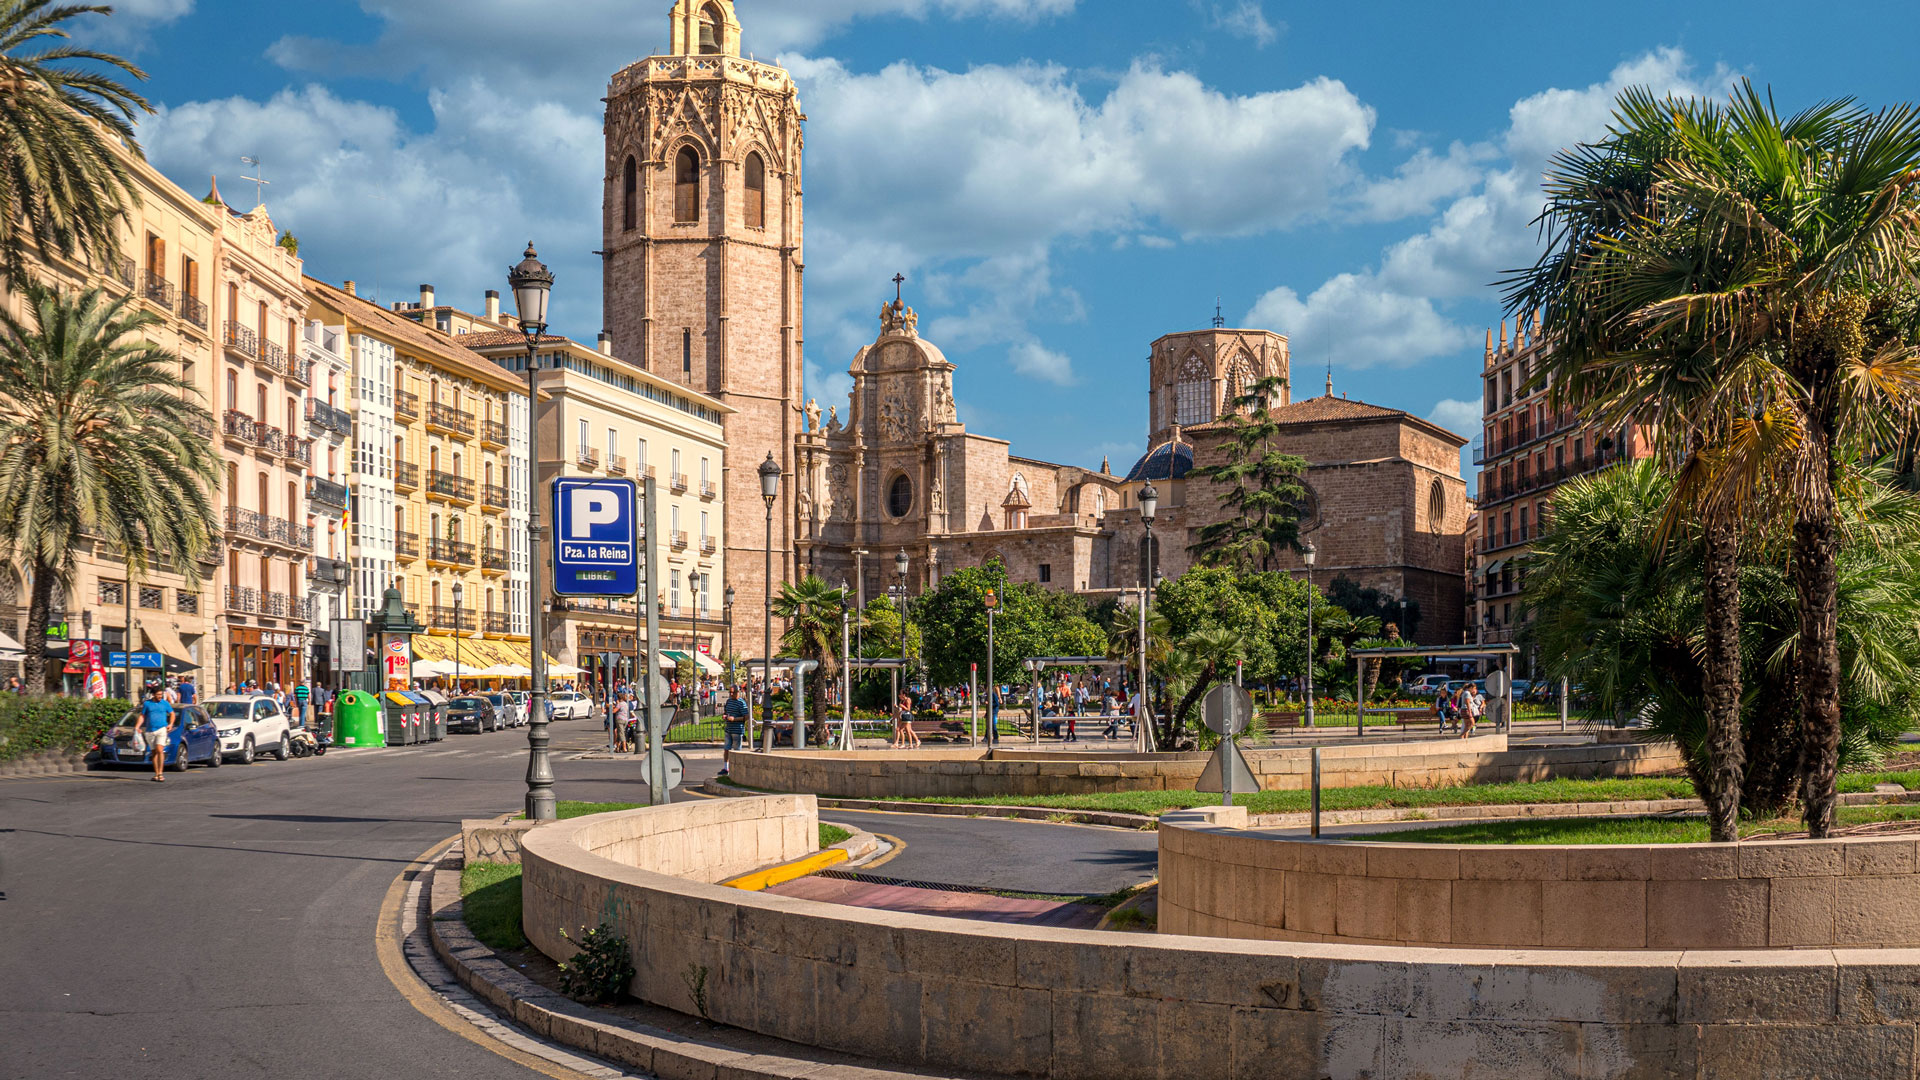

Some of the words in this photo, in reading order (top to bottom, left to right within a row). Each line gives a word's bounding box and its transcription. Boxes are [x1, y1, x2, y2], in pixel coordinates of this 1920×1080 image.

[571, 489, 619, 538] P
[564, 545, 585, 558] Pza.
[588, 546, 597, 558] la
[599, 546, 627, 559] Reina
[582, 571, 609, 580] LIBRE
